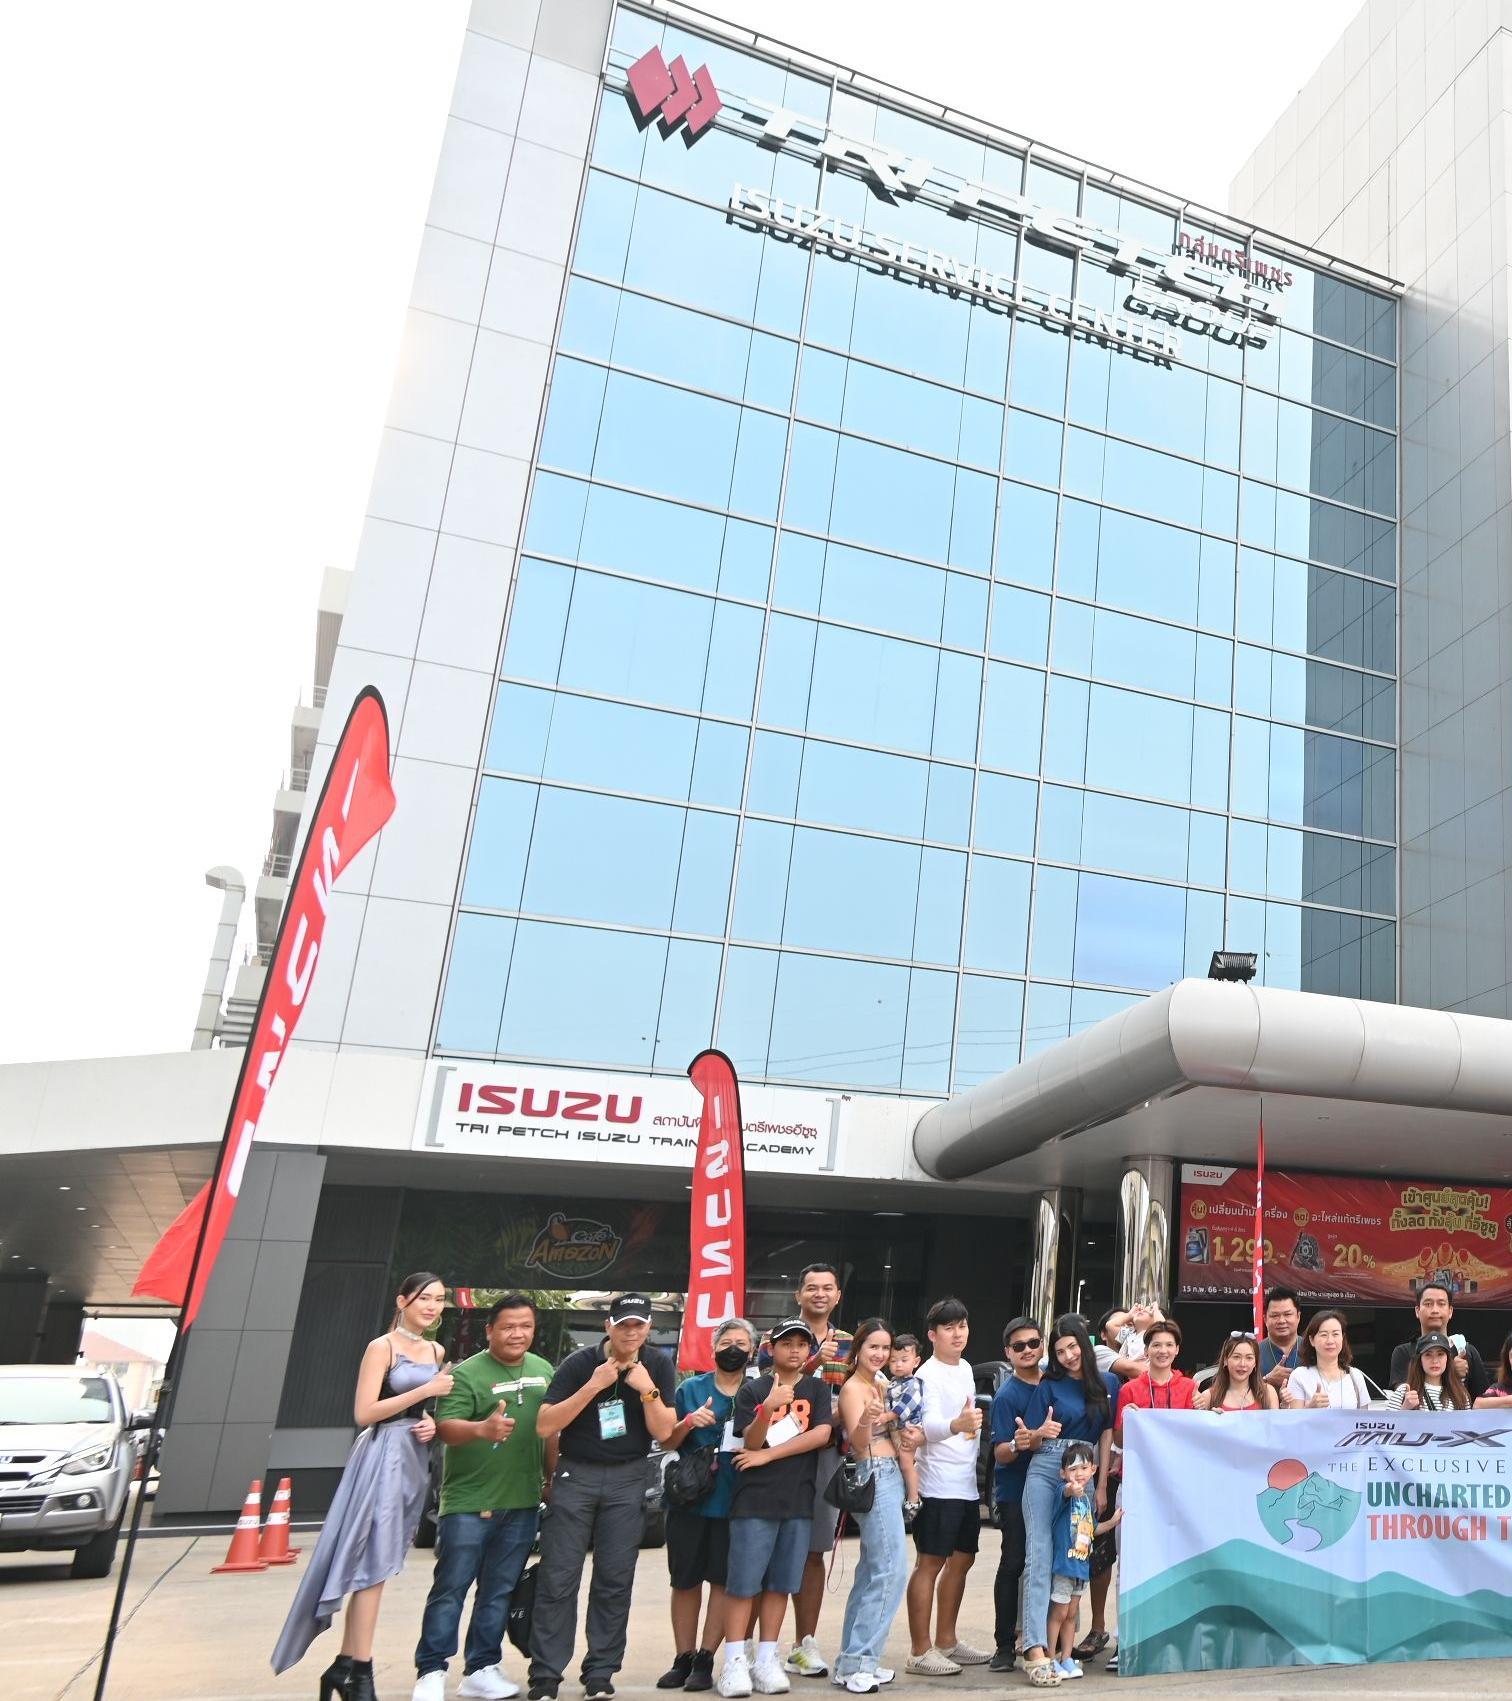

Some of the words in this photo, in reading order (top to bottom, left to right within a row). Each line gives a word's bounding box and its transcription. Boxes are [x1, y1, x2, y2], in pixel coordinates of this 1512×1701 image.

[729, 182, 861, 250] ISUZU
[457, 1083, 643, 1124] ISUZU
[456, 1122, 488, 1135] TRI
[497, 1125, 569, 1139] PETCH
[577, 1131, 641, 1144] ISUZU
[741, 1143, 815, 1156] CADEMY
[1193, 1170, 1223, 1179] ISUZU
[1183, 1285, 1191, 1293] 15
[1355, 1422, 1395, 1430] ISUZU
[1328, 1462, 1358, 1472] THE
[1368, 1456, 1507, 1474] EXCLUSIVE
[1367, 1482, 1511, 1509] UNCHARTED
[1367, 1514, 1487, 1541] THROUGH
